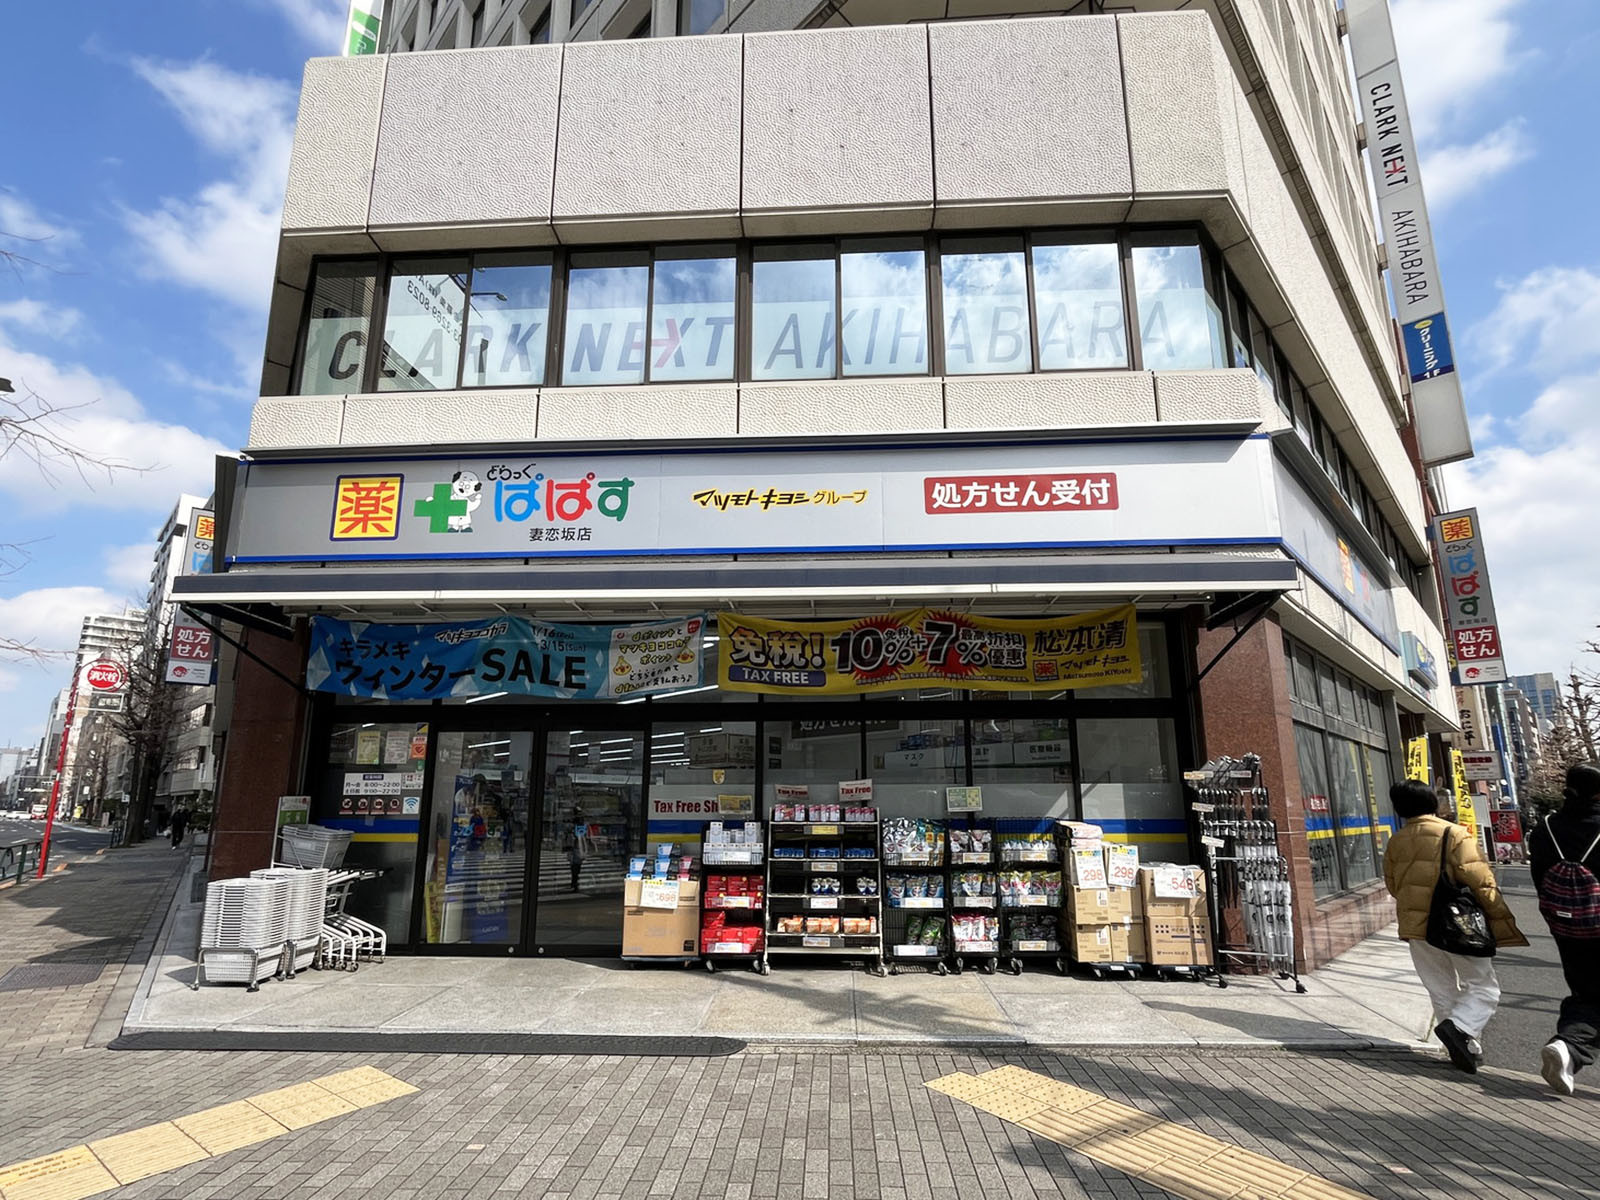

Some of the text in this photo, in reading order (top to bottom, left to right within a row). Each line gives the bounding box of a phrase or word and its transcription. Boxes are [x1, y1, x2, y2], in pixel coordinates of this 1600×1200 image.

[1370, 82, 1409, 188] CLARK NEXT
[1391, 209, 1430, 306] AKIHABARA
[328, 300, 1176, 380] CLARK NEXT AKIHABARA
[486, 463, 537, 481] どらっぐ
[493, 472, 635, 522] ぱぱす
[931, 478, 1111, 509] 処方せん受付
[340, 481, 396, 534] 薬
[528, 527, 592, 542] 妻恋坂店
[1443, 518, 1470, 541] 薬
[177, 628, 212, 645] 処方
[1032, 618, 1129, 657] 松本清
[1458, 628, 1494, 646] 処方
[175, 643, 209, 658] せん
[340, 638, 410, 660] キラメキ
[1460, 644, 1496, 659] せん
[89, 670, 118, 683] 消火栓
[336, 647, 587, 692] ウィンター SALE
[741, 667, 810, 684] TAX FREE
[904, 752, 925, 761] マスク
[841, 785, 871, 796] Tax Free
[654, 799, 674, 813] Tax
[676, 799, 701, 813] Free
[1083, 869, 1105, 882] 298
[1113, 866, 1135, 880] 298
